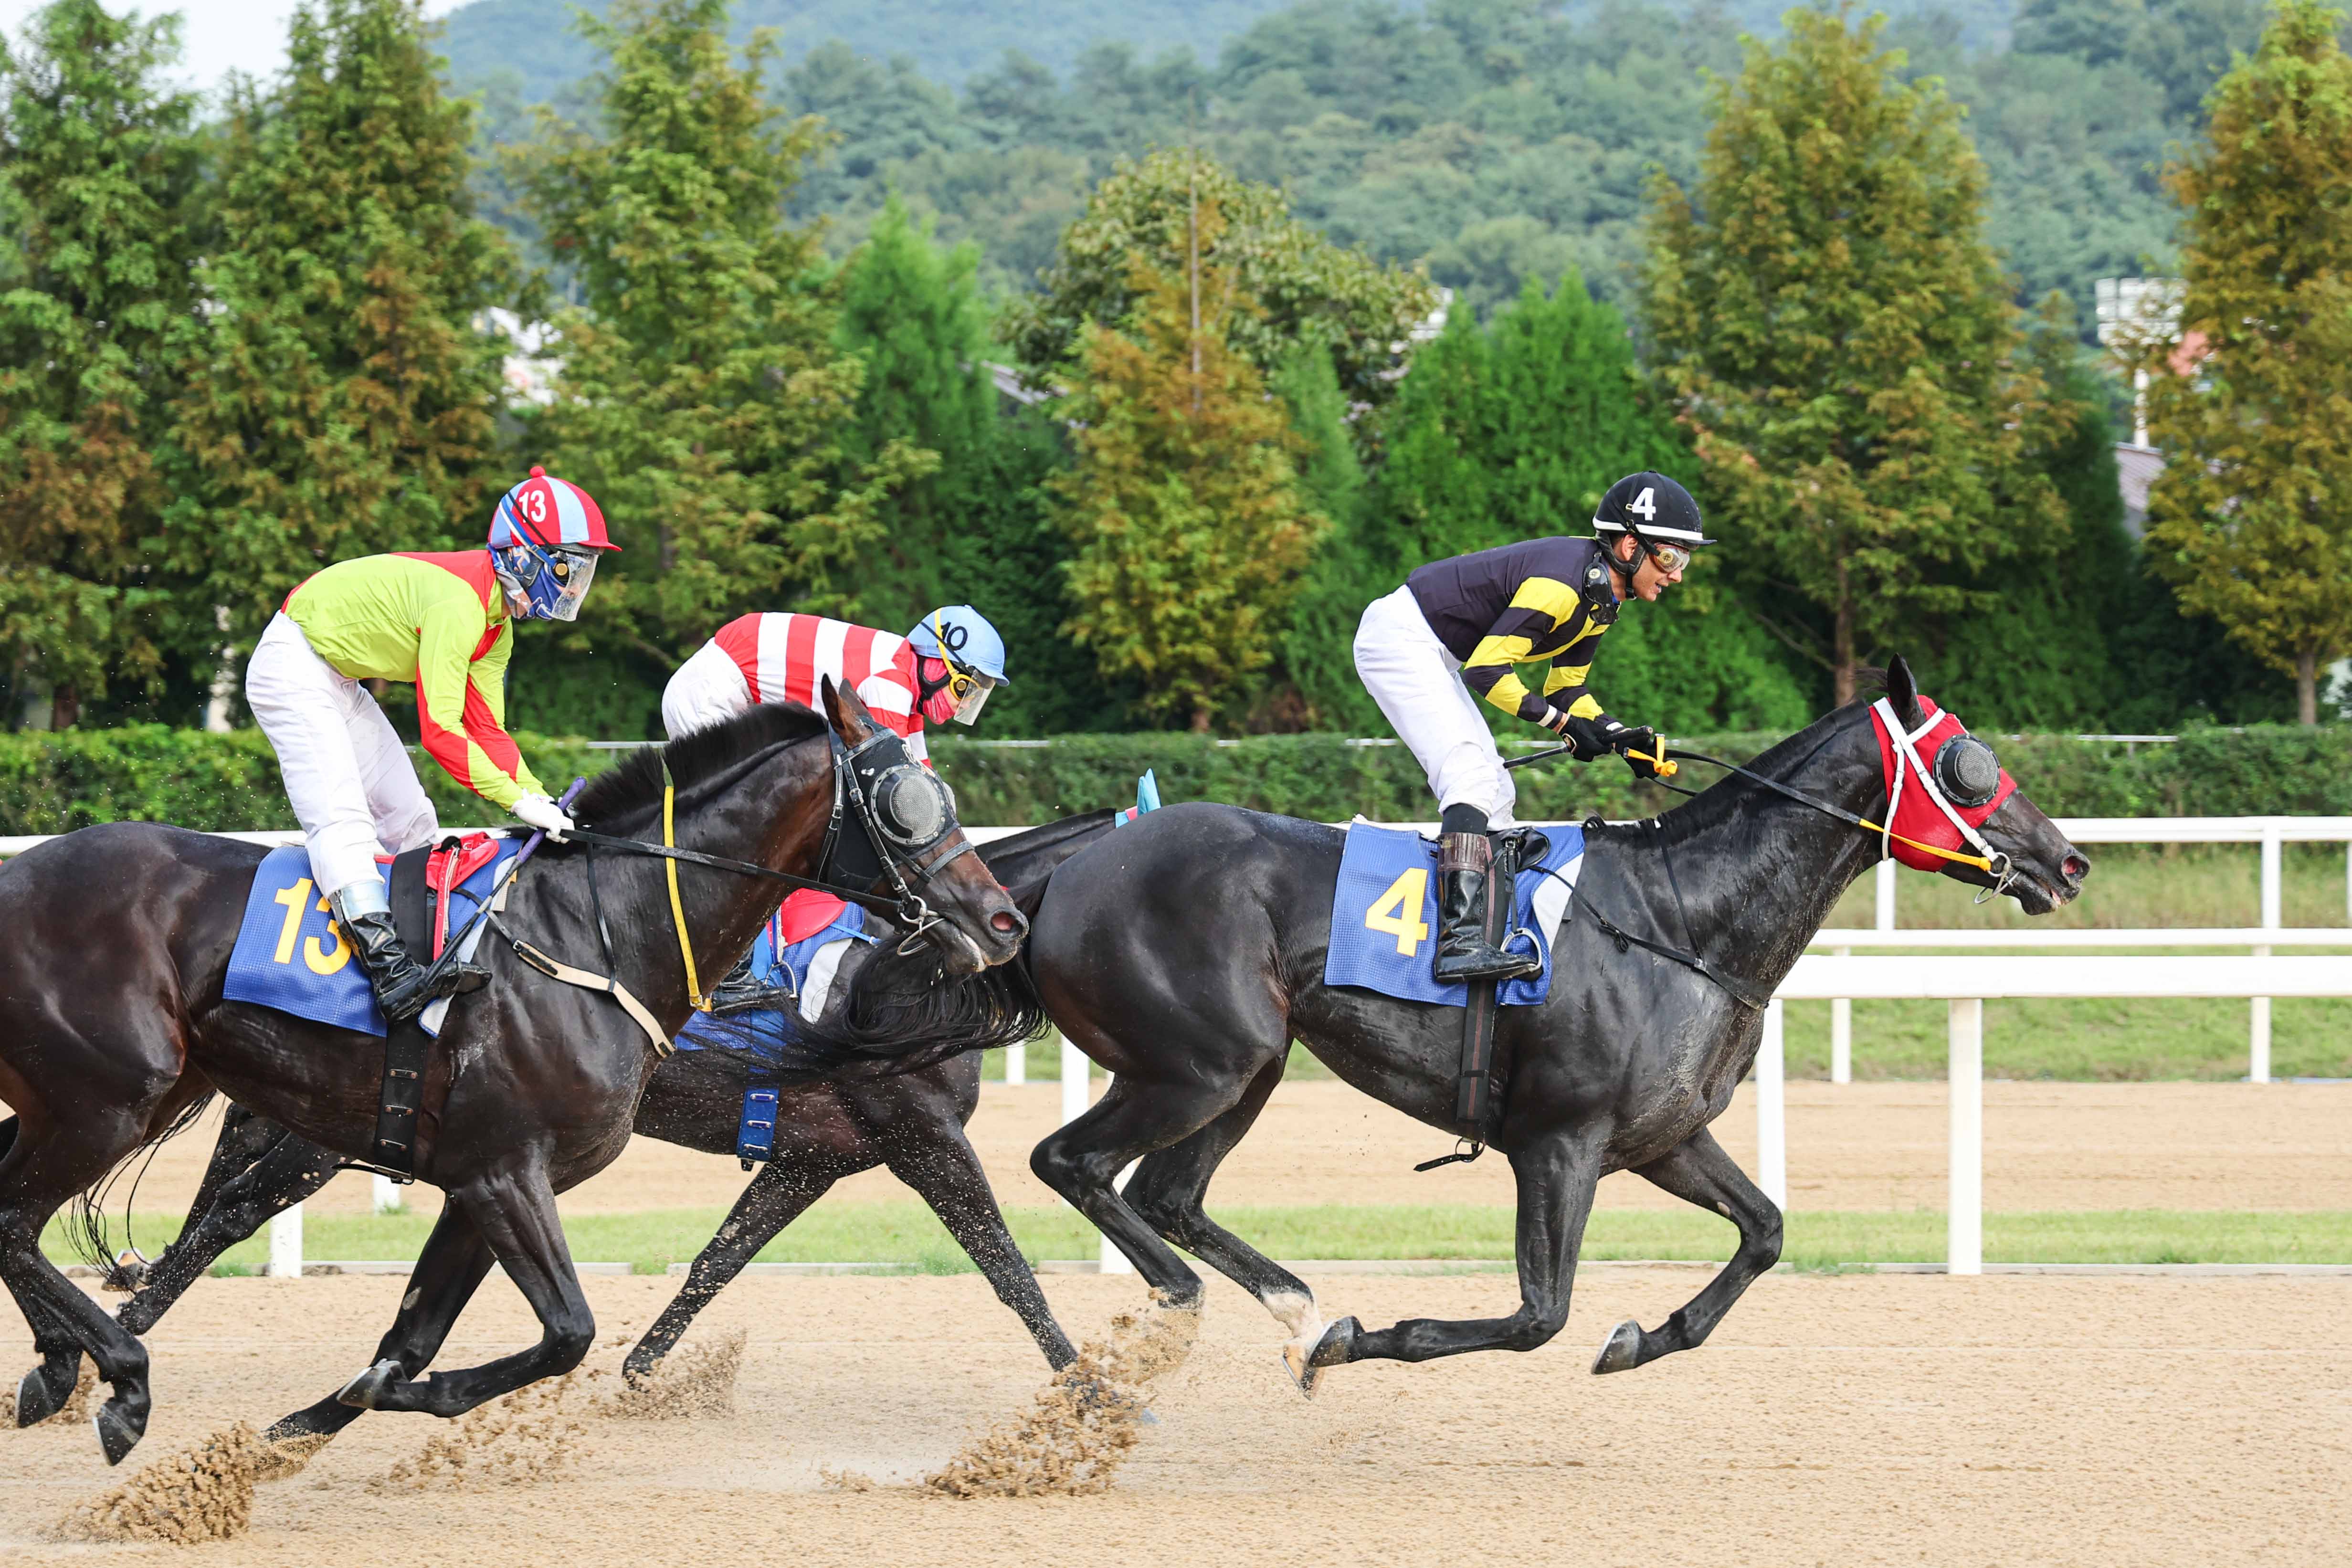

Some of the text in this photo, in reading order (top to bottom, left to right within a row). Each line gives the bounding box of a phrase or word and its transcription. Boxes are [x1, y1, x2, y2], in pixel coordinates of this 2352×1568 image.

[519, 490, 547, 523] 13
[1632, 487, 1656, 520] 4
[274, 877, 351, 975] 13
[1365, 867, 1429, 957] 4
